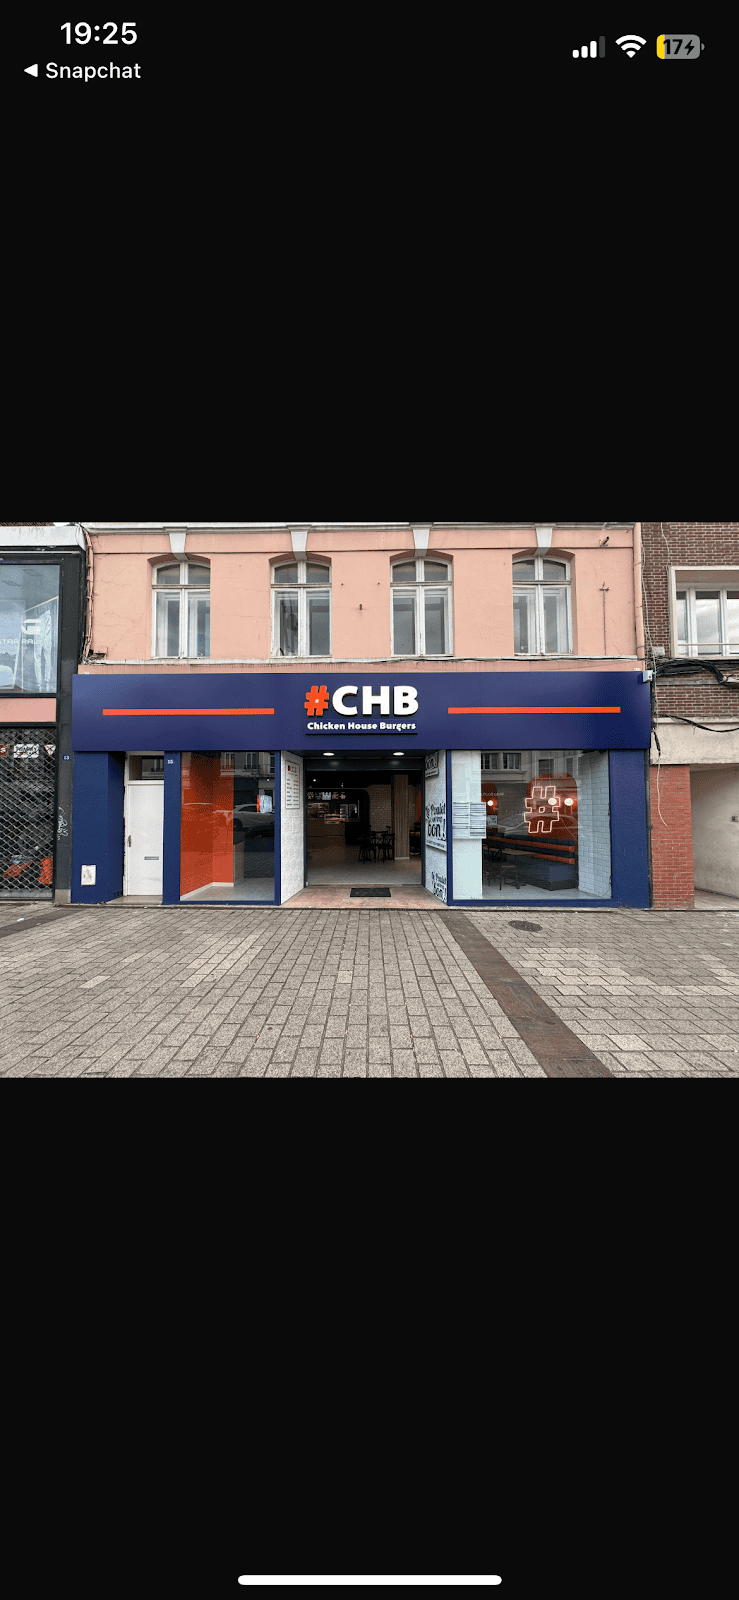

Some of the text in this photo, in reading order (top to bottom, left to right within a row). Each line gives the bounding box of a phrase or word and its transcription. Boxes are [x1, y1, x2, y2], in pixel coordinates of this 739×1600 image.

[304, 685, 419, 717] #CHB
[307, 722, 417, 732] Chicken House Burgers
